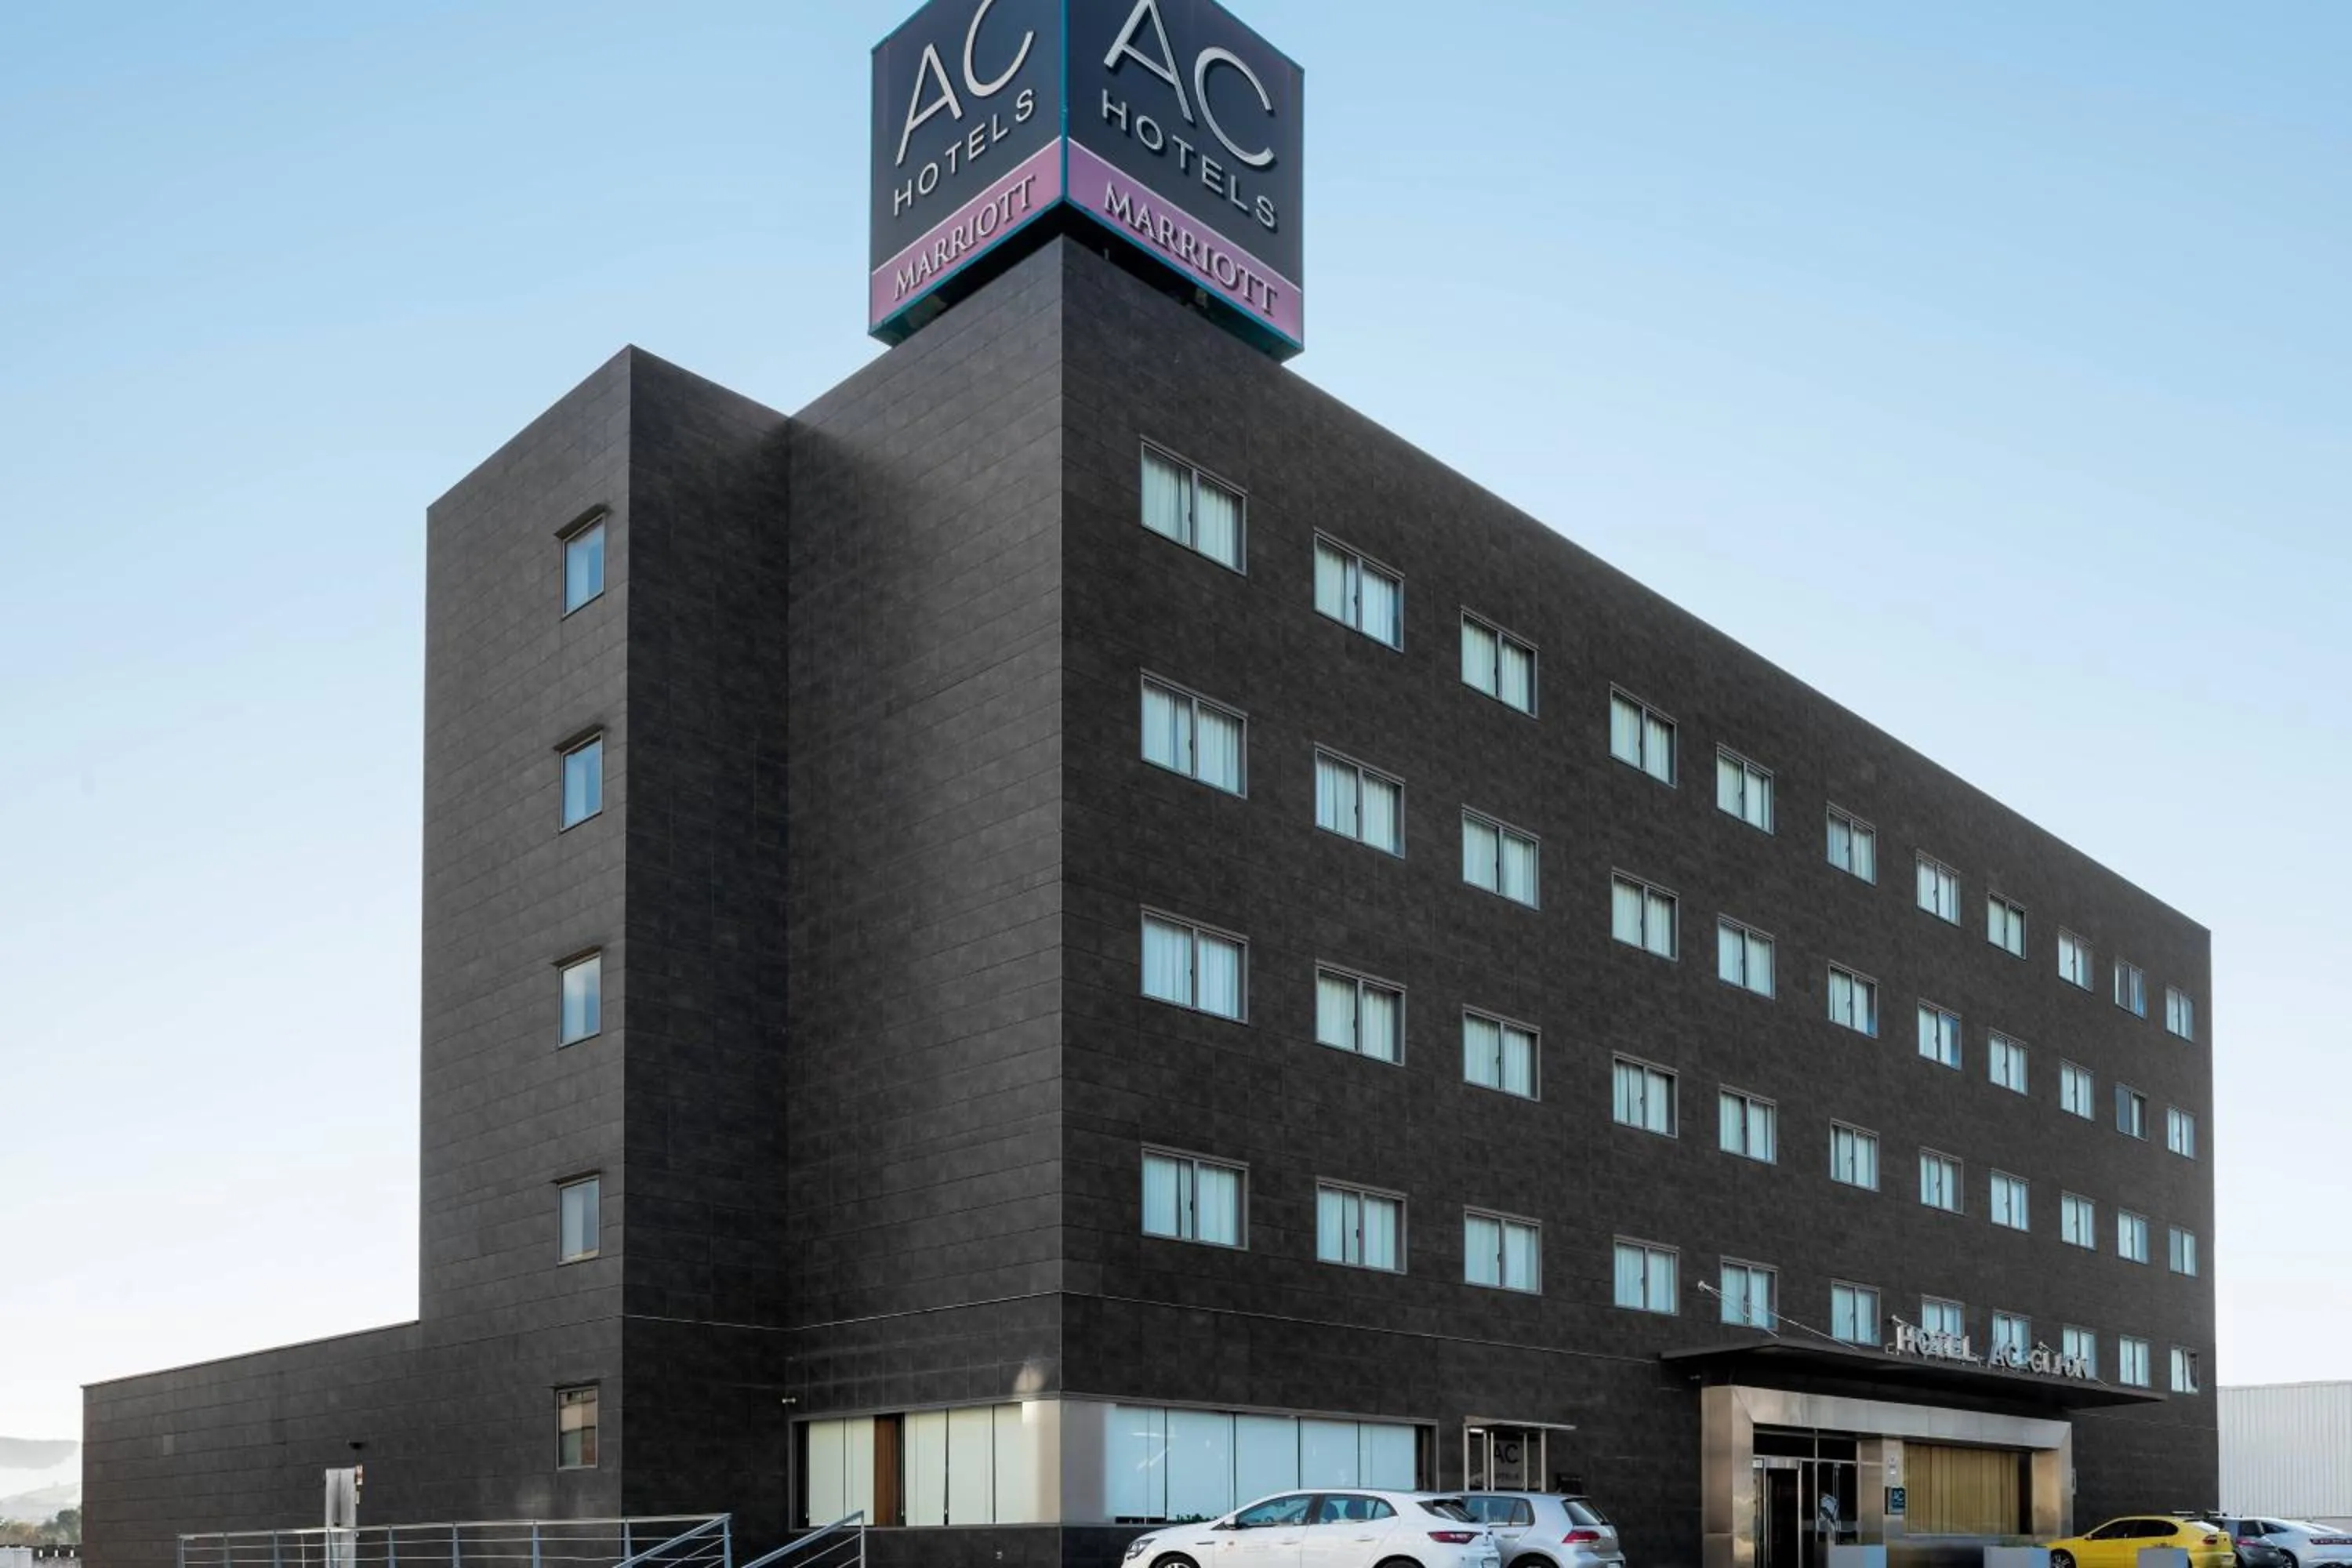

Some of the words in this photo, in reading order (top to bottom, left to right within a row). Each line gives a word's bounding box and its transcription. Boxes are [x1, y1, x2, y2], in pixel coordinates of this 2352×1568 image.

[894, 88, 1036, 217] HOTELS
[895, 0, 1035, 167] AC
[1103, 0, 1275, 167] AC
[1102, 89, 1278, 228] HOTELS
[893, 174, 1036, 301] MARRIOTT
[1104, 180, 1279, 317] MARRIOTT
